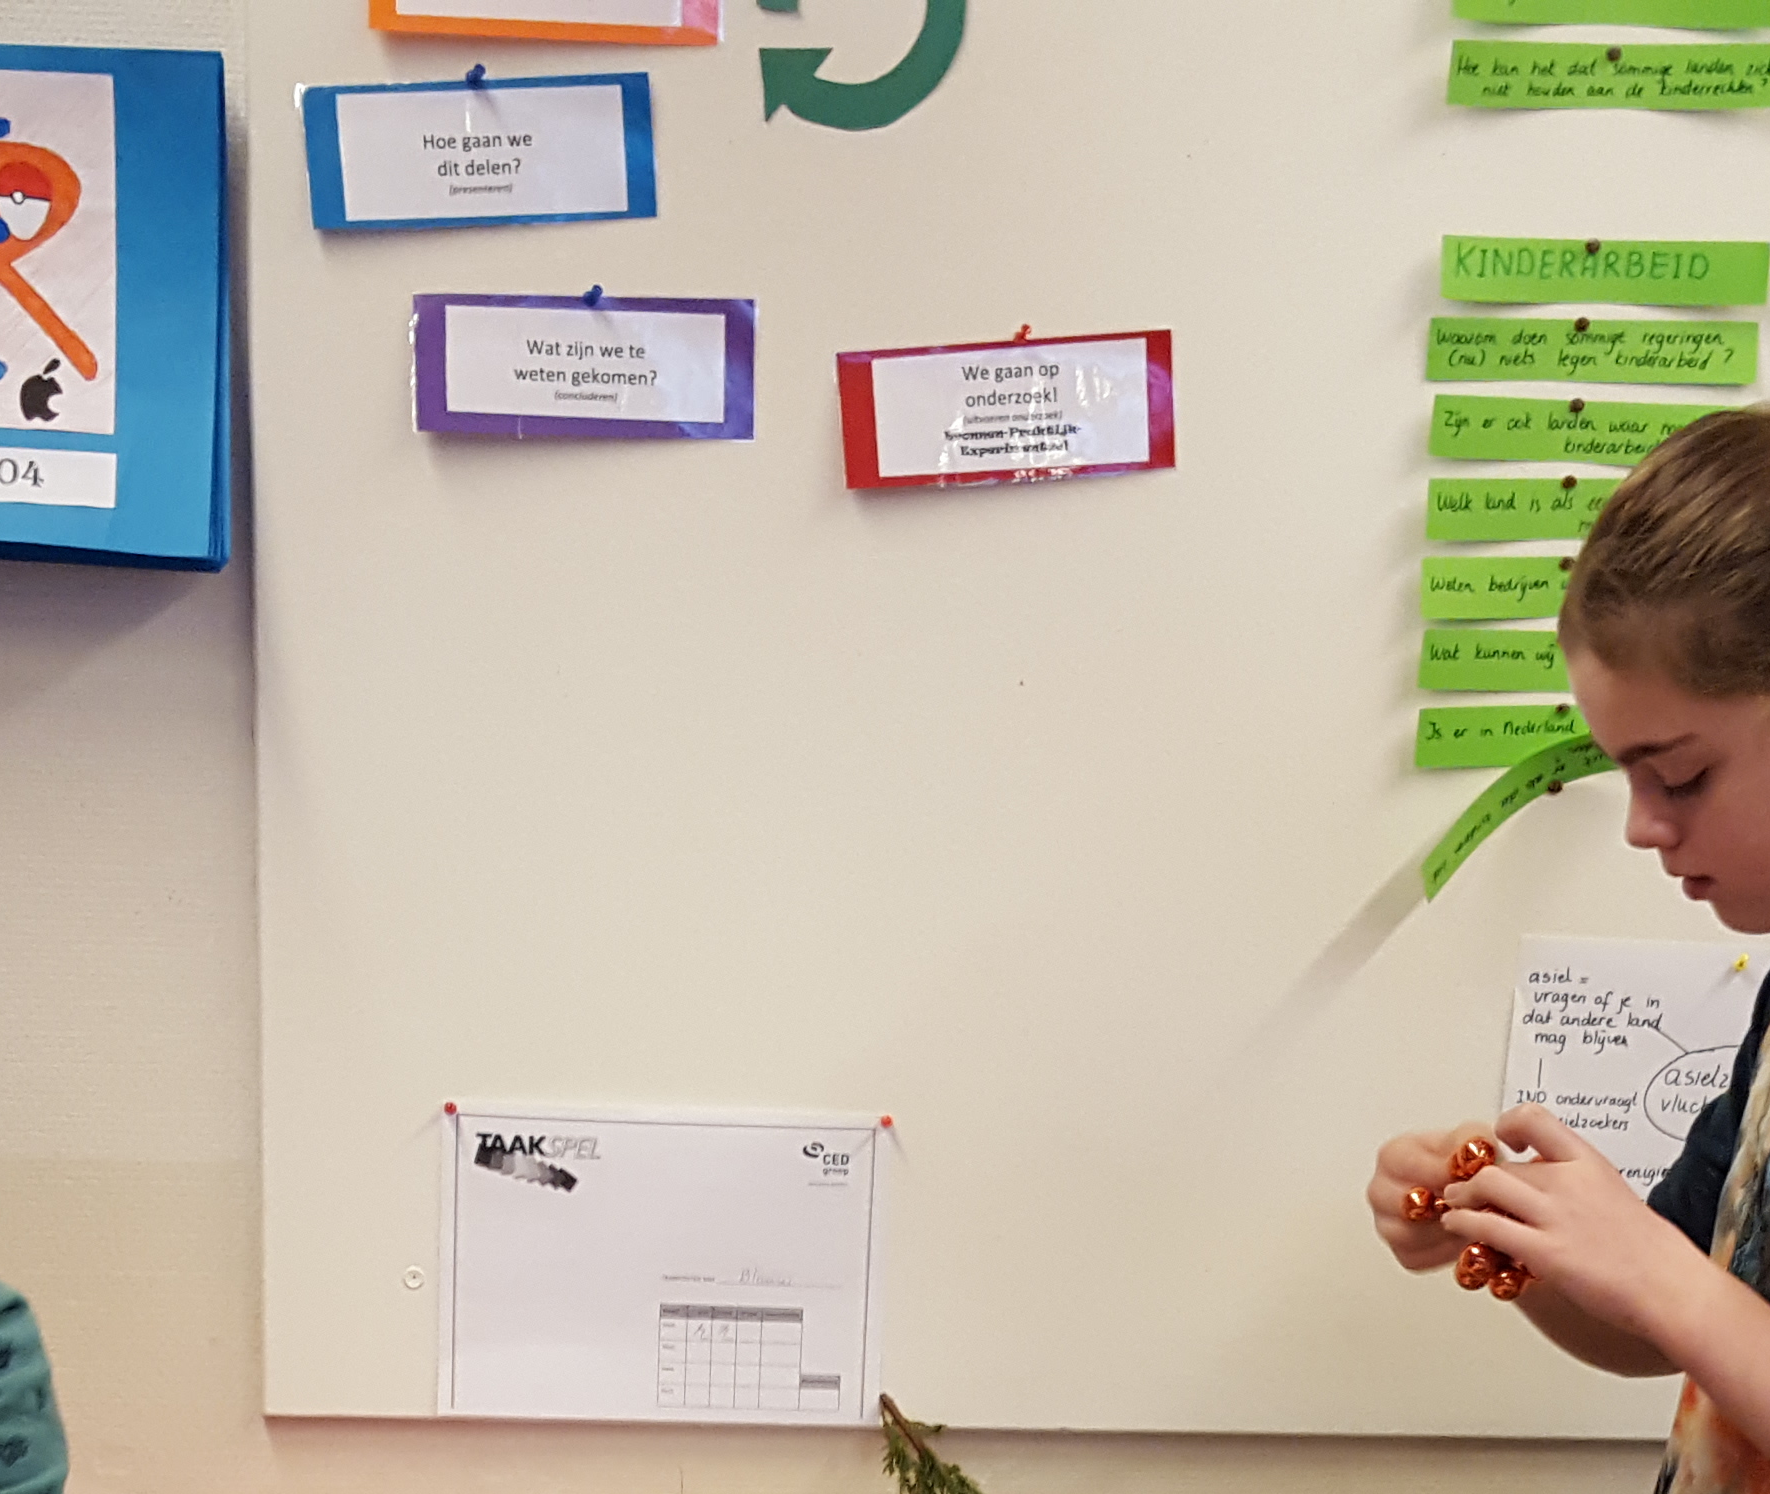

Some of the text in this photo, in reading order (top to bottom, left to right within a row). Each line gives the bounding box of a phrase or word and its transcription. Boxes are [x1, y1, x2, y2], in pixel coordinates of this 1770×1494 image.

[422, 133, 533, 154] Hoe gaan we
[436, 158, 522, 178] dit delen?
[1454, 241, 1712, 281] KINDERARBEID
[526, 339, 647, 361] Wat zijn we te
[513, 366, 658, 388] weten gekomen?
[961, 362, 1061, 384] We gaan op
[964, 386, 1059, 409] onderzoek!
[1528, 967, 1572, 984] asiel
[1533, 990, 1661, 1015] vragen of je in
[1522, 1010, 1664, 1031] dat andere land
[1533, 1030, 1629, 1055] mag blijven
[1555, 1092, 1639, 1114] ondervraagt
[1562, 1113, 1630, 1132] ielzoekers
[822, 1152, 851, 1167] CED
